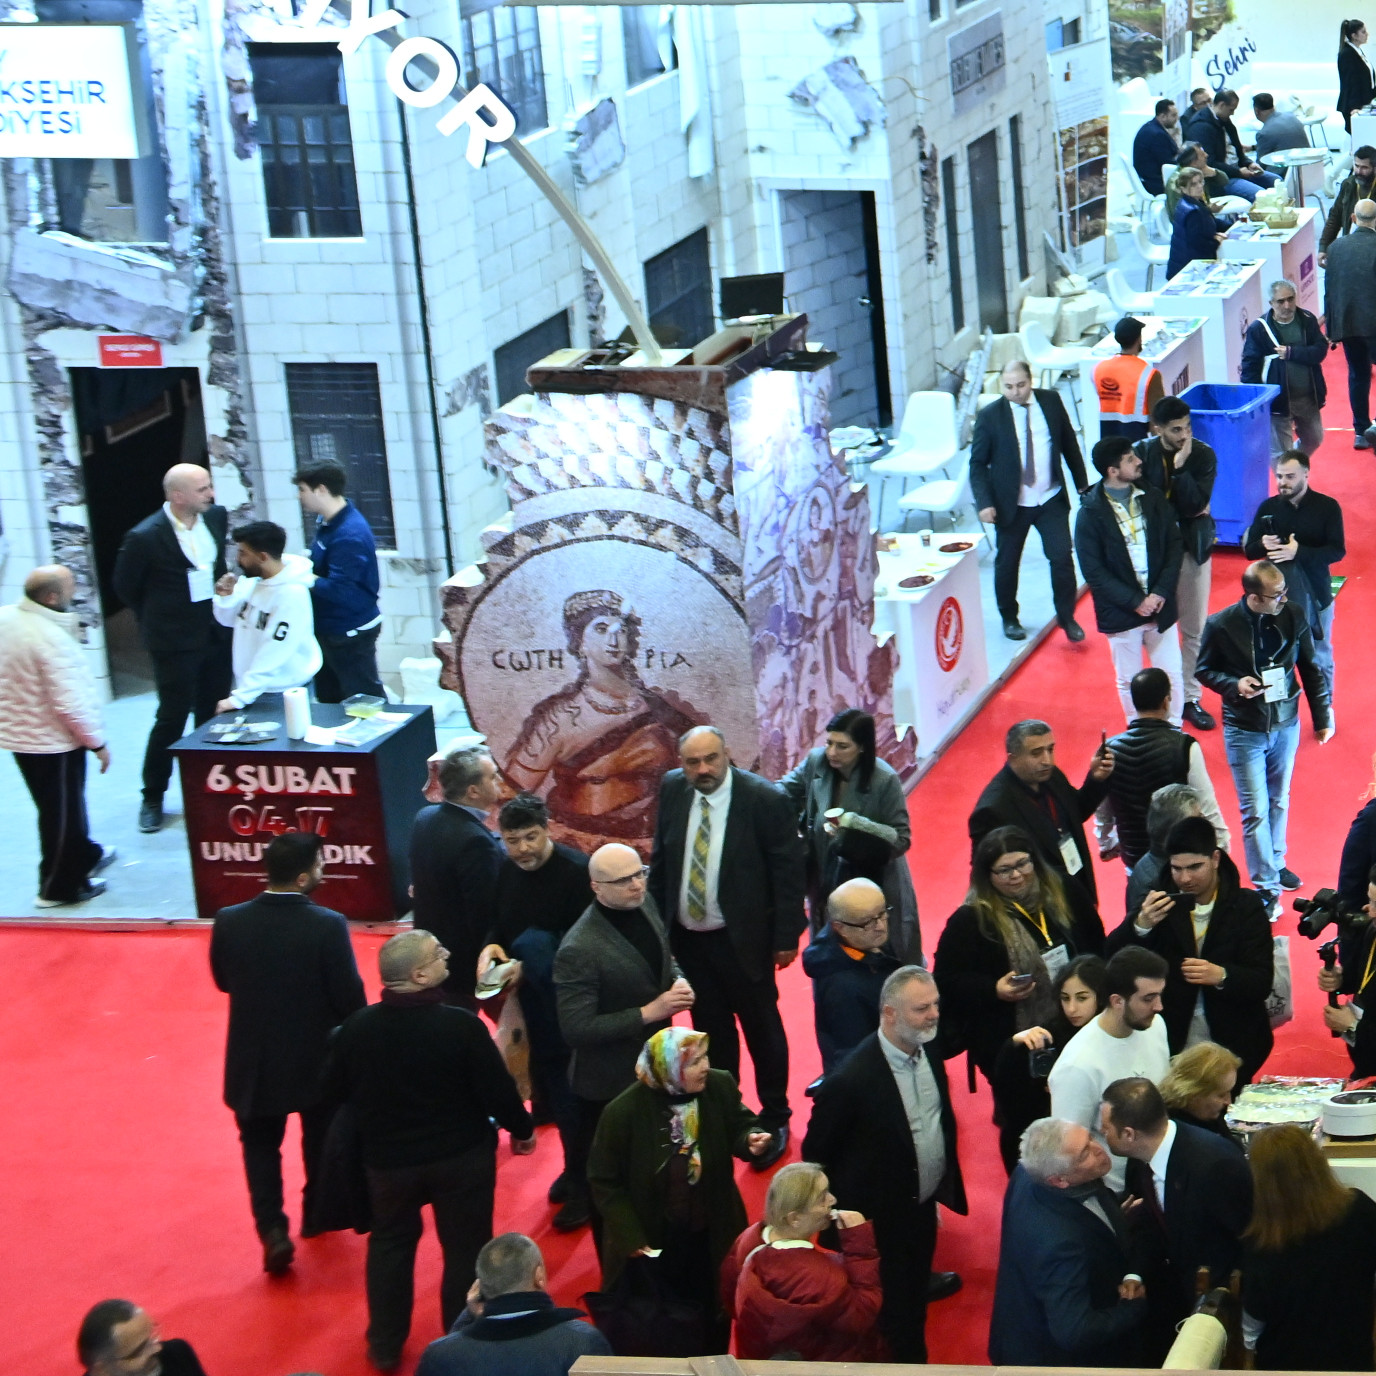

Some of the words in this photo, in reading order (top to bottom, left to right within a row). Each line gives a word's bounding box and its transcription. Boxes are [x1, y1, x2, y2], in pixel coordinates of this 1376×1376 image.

[207, 764, 232, 792] 6
[235, 764, 357, 801] ŞUBAT
[200, 841, 376, 866] UNUDIK
